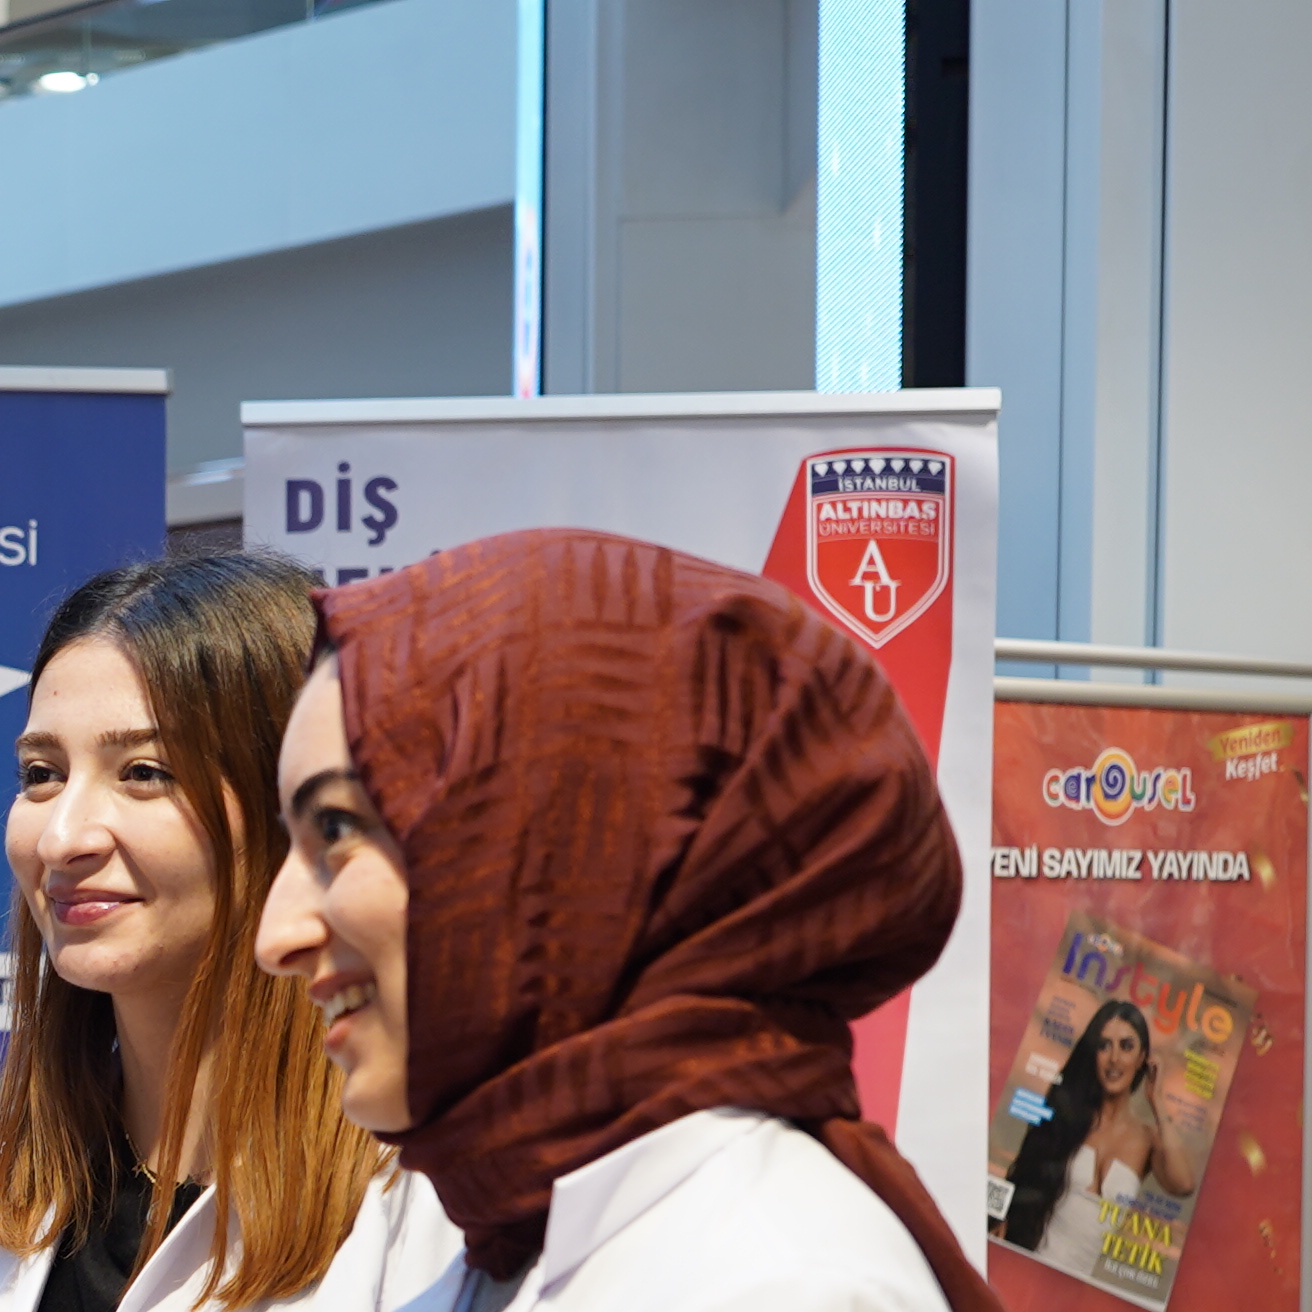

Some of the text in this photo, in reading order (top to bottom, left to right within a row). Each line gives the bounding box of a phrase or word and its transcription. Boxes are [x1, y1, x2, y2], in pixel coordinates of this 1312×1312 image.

[286, 461, 399, 546] DİŞ
[1042, 847, 1143, 880] SAYIMIZ
[1147, 850, 1251, 882] YAYINDA
[1098, 1200, 1171, 1248] TUANA
